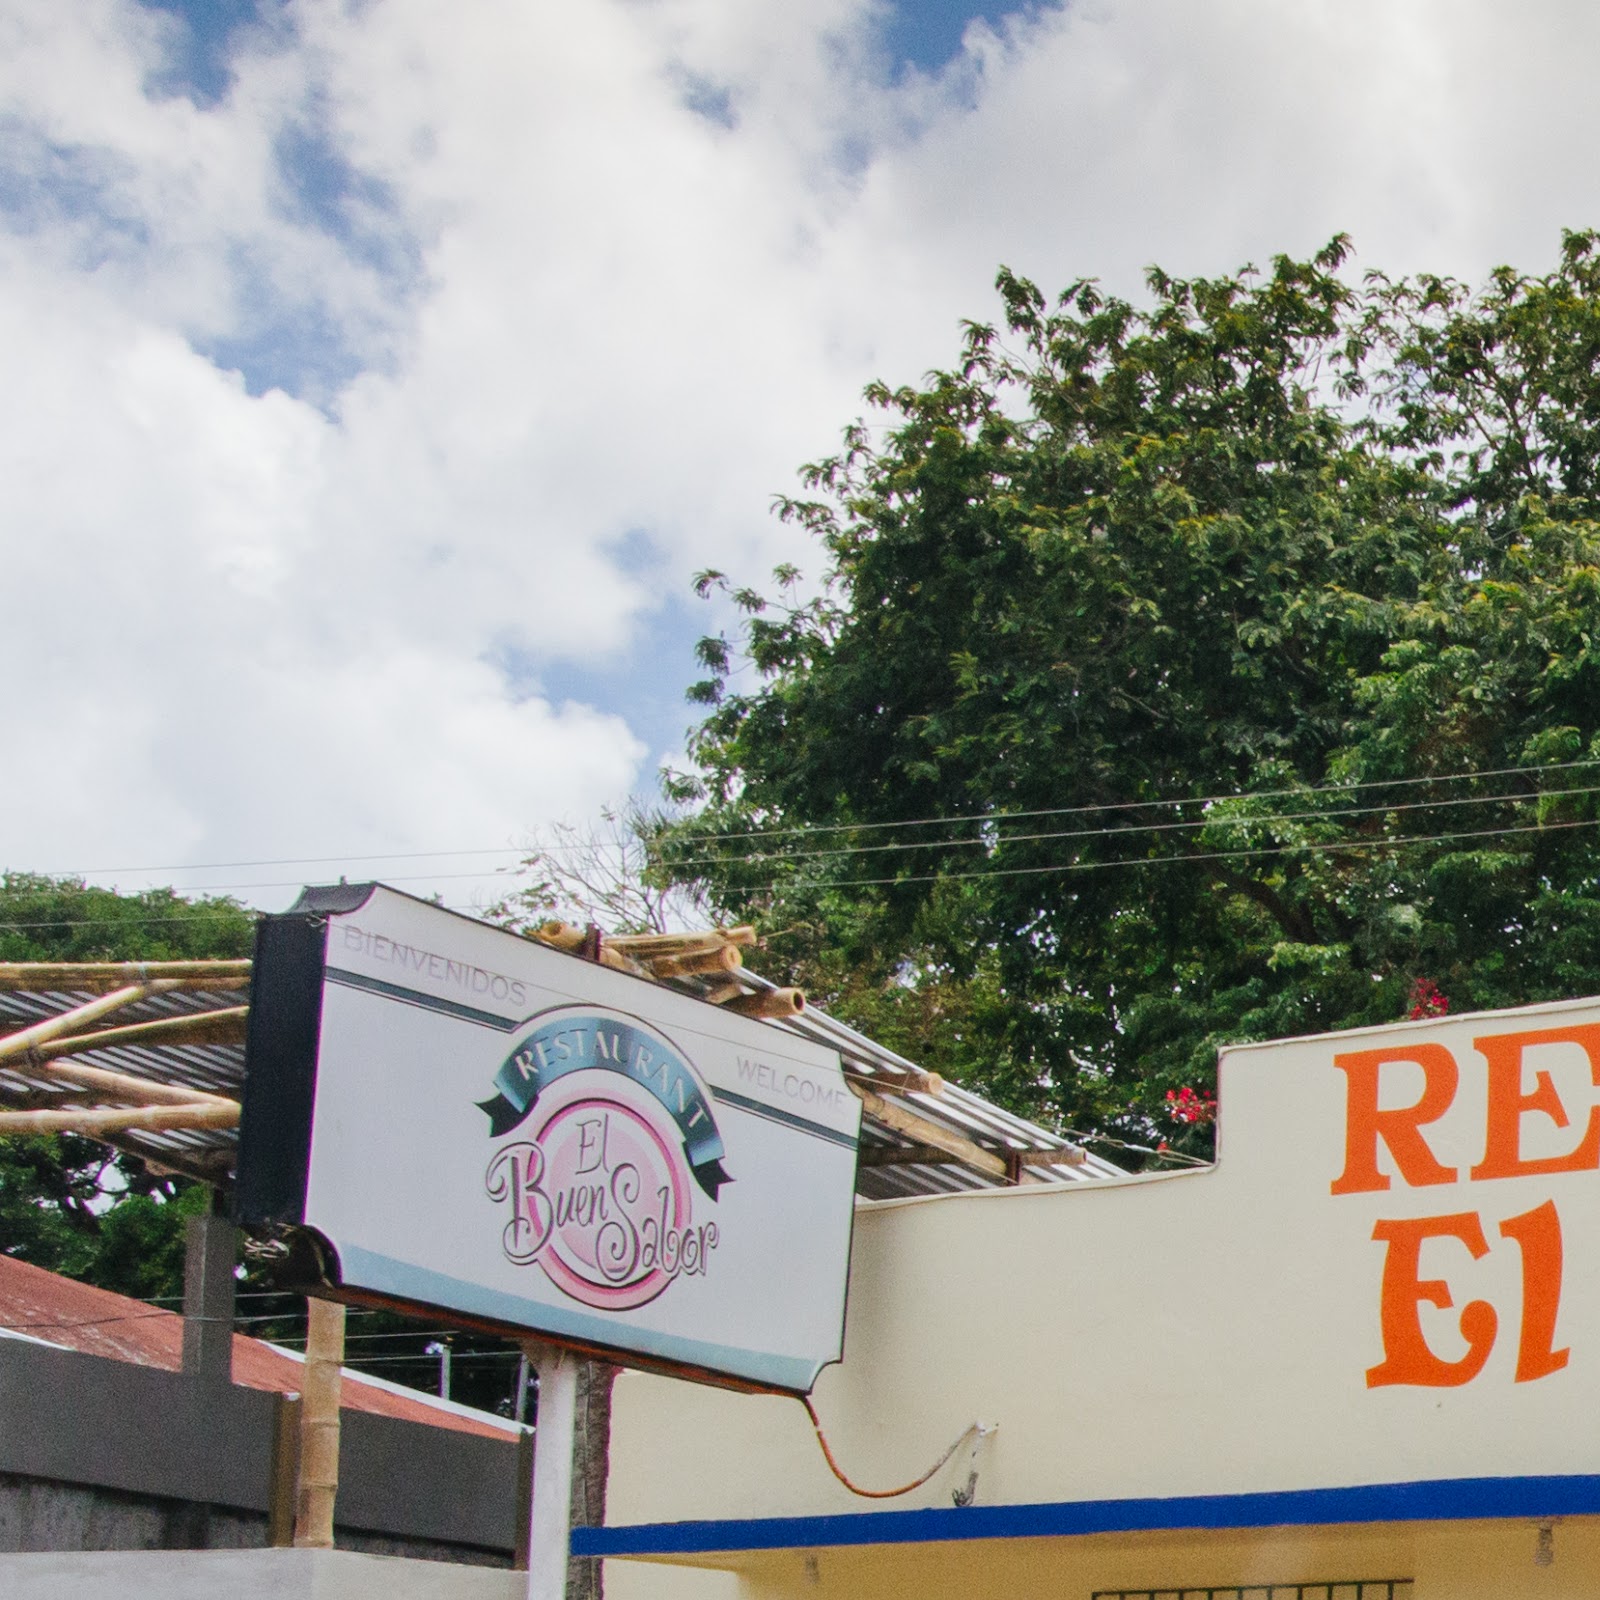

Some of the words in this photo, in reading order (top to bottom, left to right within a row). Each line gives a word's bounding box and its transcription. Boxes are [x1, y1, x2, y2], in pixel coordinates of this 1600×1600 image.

[344, 925, 527, 1008] BIENVENIDOS
[514, 1027, 709, 1128] RESTAURANT
[737, 1056, 850, 1112] WELCOME
[575, 1113, 609, 1175] El
[485, 1141, 609, 1260] Buen
[595, 1162, 720, 1283] Sabor
[1366, 1201, 1570, 1387] El
